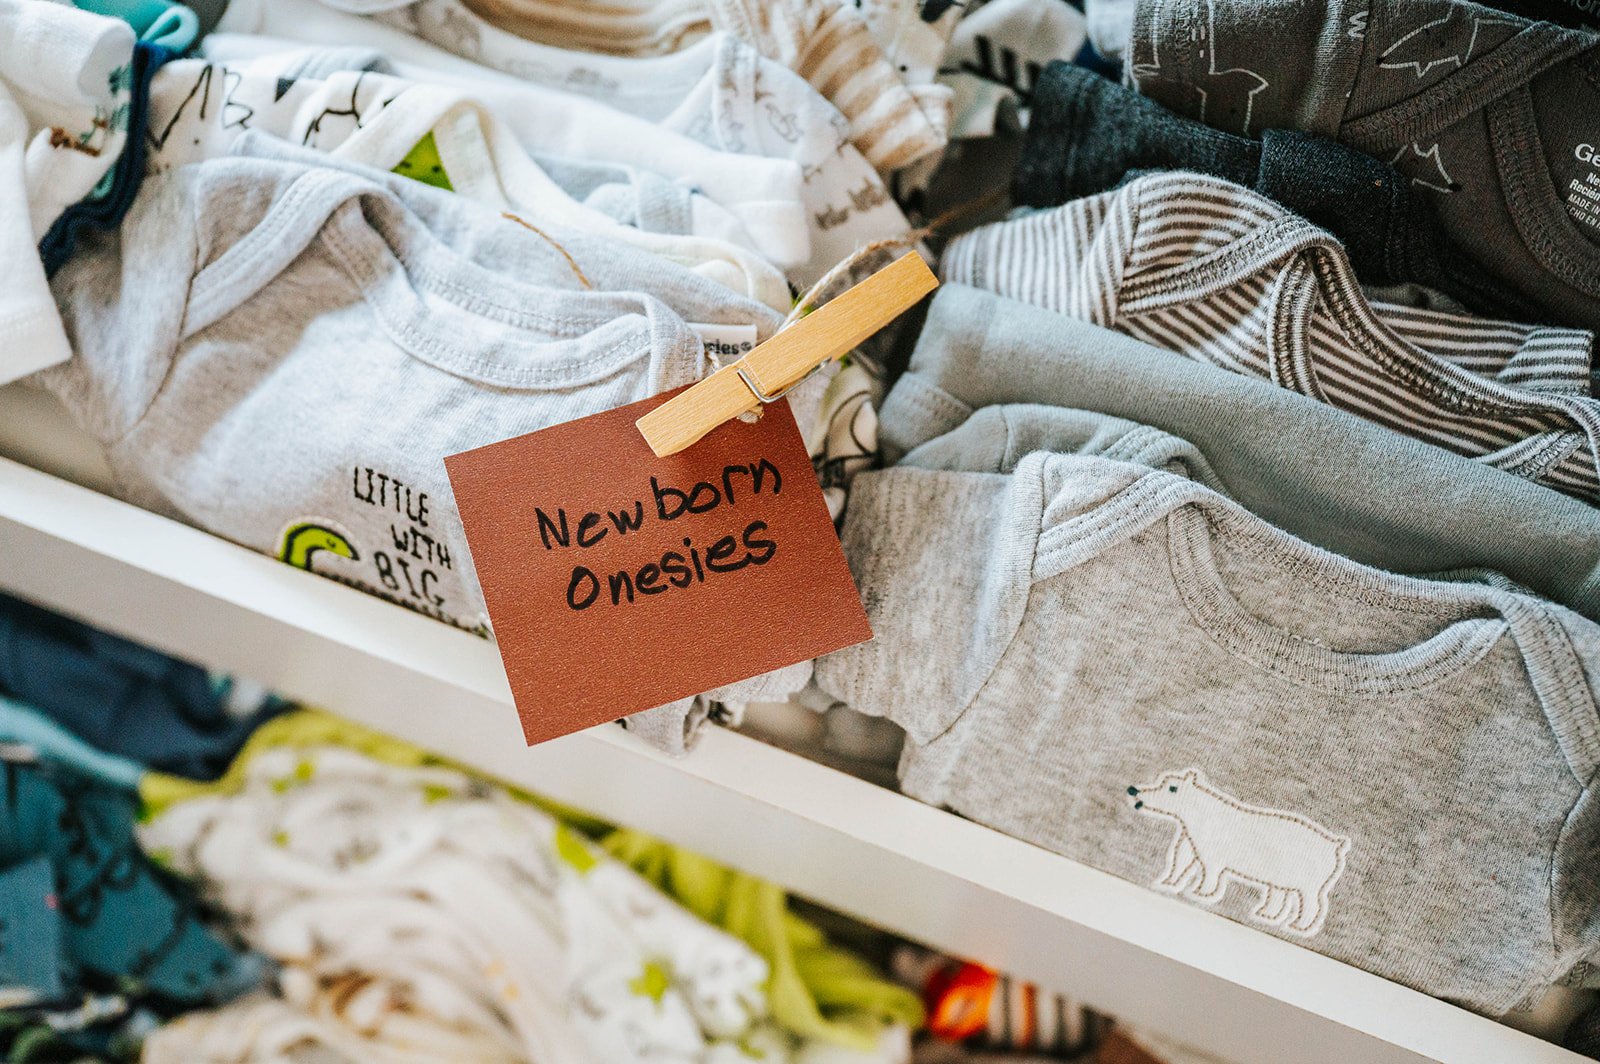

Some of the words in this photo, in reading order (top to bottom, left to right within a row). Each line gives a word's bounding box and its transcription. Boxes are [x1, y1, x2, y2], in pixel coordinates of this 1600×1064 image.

[1568, 193, 1591, 211] MADE
[1585, 215, 1597, 226] EN
[353, 466, 429, 528] LITTLE
[534, 458, 782, 550] Newborn
[390, 523, 452, 570] WITH
[566, 520, 777, 610] Onesies
[374, 551, 446, 607] BIG
